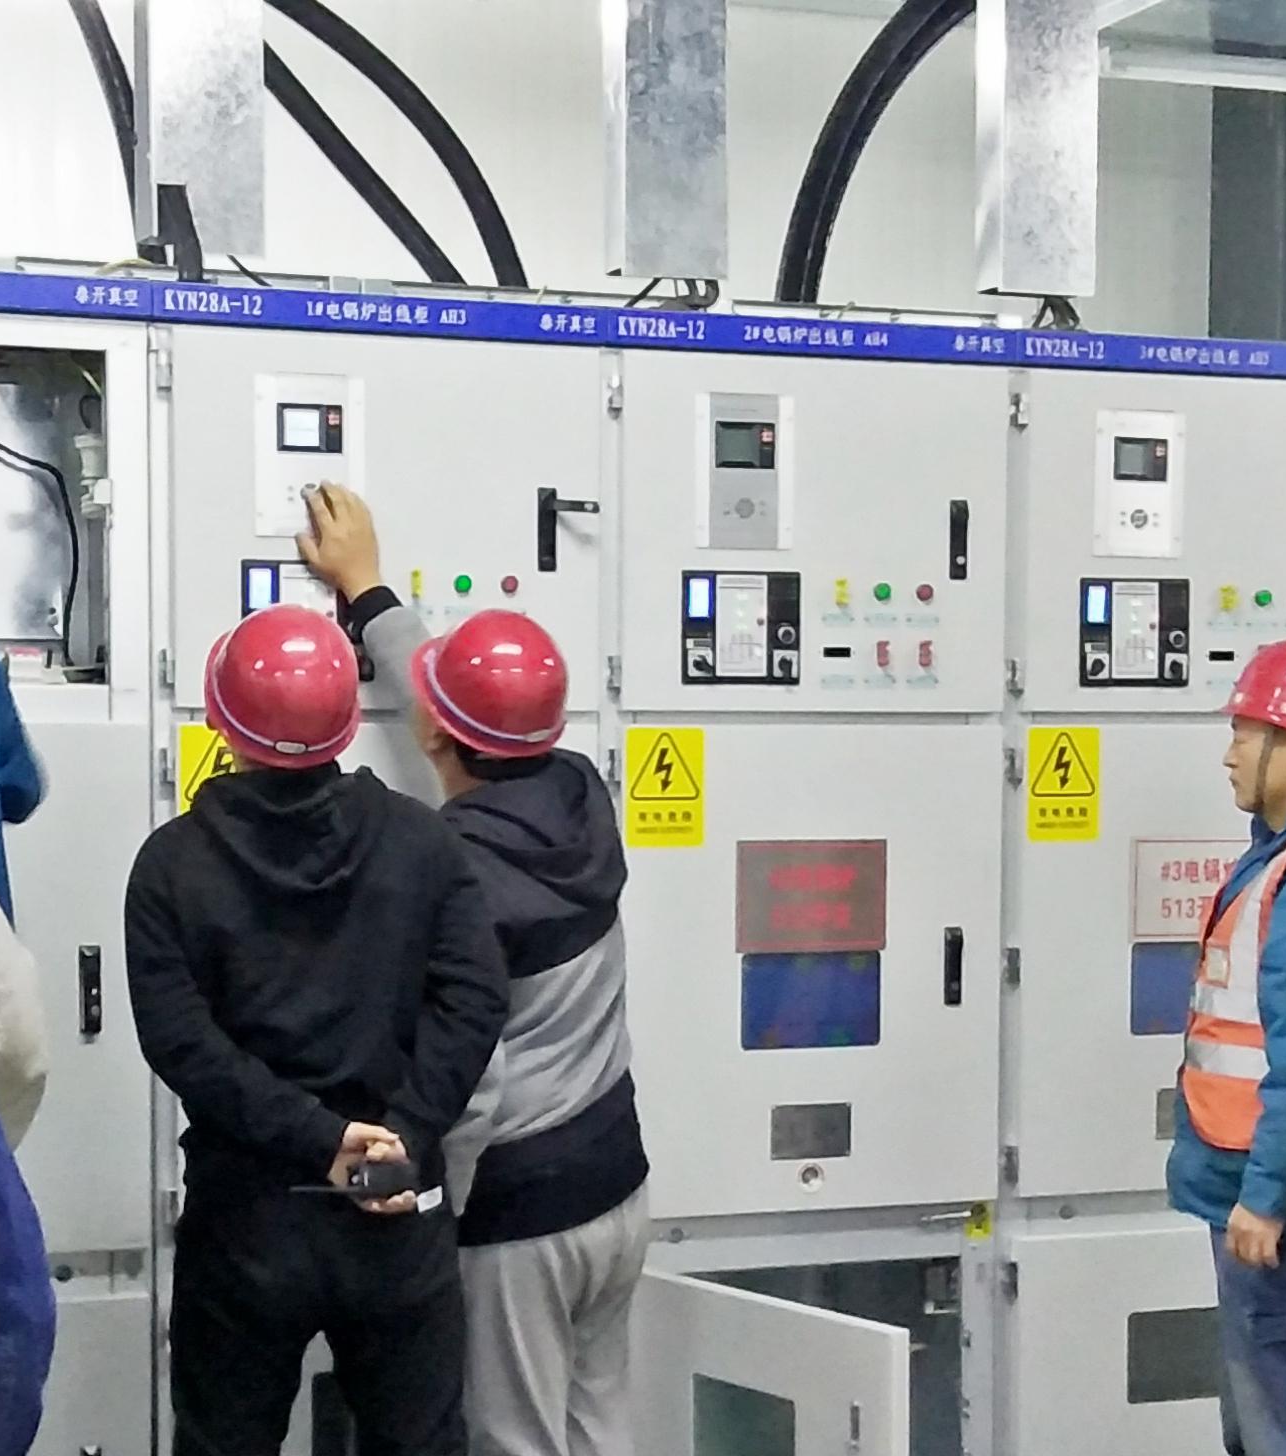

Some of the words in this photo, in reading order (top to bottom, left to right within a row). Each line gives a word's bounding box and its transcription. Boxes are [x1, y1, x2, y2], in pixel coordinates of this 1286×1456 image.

[164, 288, 263, 315] KYN28A-12
[439, 309, 467, 325] AH3
[618, 315, 705, 340] KYN28A-12
[864, 332, 888, 346] AH4
[1025, 337, 1104, 360] KYN28A-12
